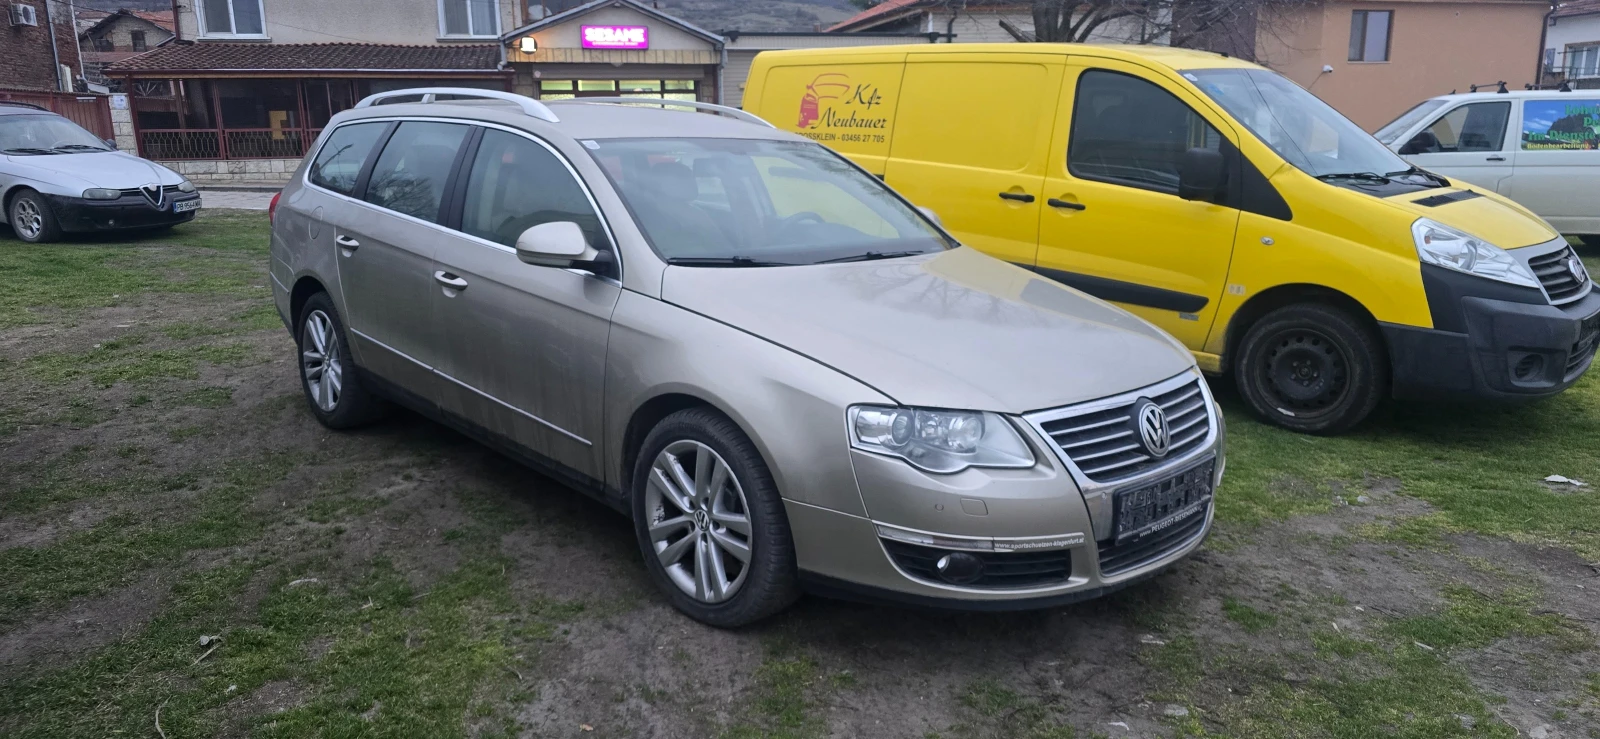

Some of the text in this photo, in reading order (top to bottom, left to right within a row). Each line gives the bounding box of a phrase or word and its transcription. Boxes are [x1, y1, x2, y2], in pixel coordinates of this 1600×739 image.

[585, 28, 645, 42] SESAME
[845, 84, 882, 110] Kfz
[810, 107, 887, 129] Neubauer
[841, 133, 861, 142] 03456
[862, 134, 871, 143] 27
[873, 135, 885, 143] 705
[1528, 130, 1595, 141] Im Dienste
